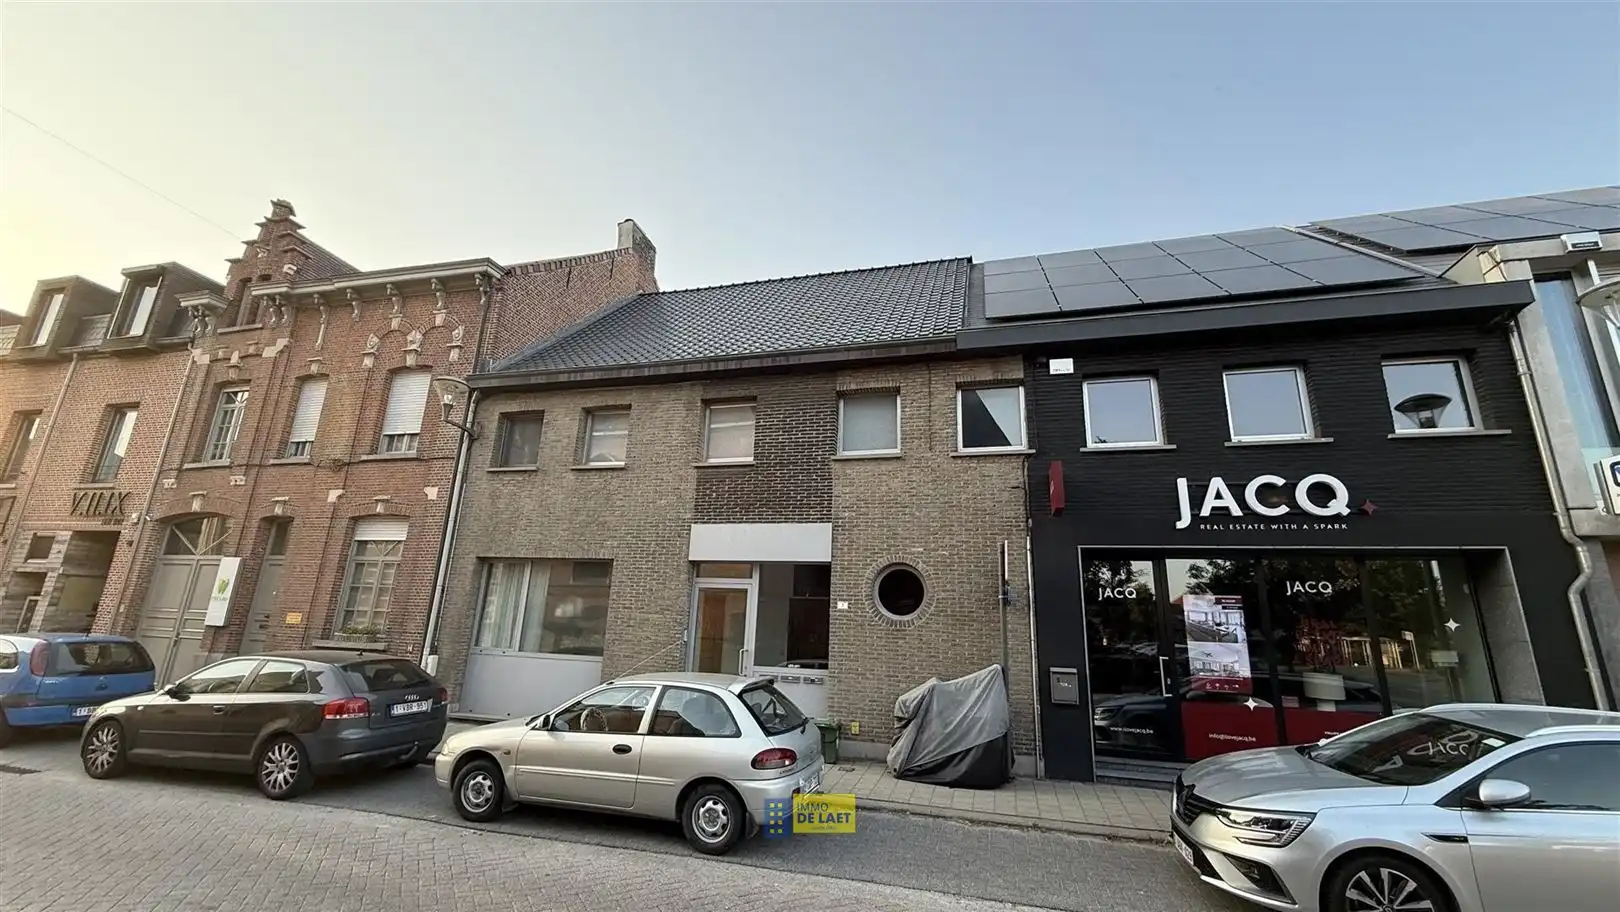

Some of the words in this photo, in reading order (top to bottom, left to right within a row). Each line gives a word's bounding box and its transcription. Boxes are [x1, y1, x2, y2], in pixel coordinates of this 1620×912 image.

[1175, 473, 1351, 529] JACQ
[1098, 587, 1137, 601] JACQ
[1286, 580, 1333, 596] JACQ
